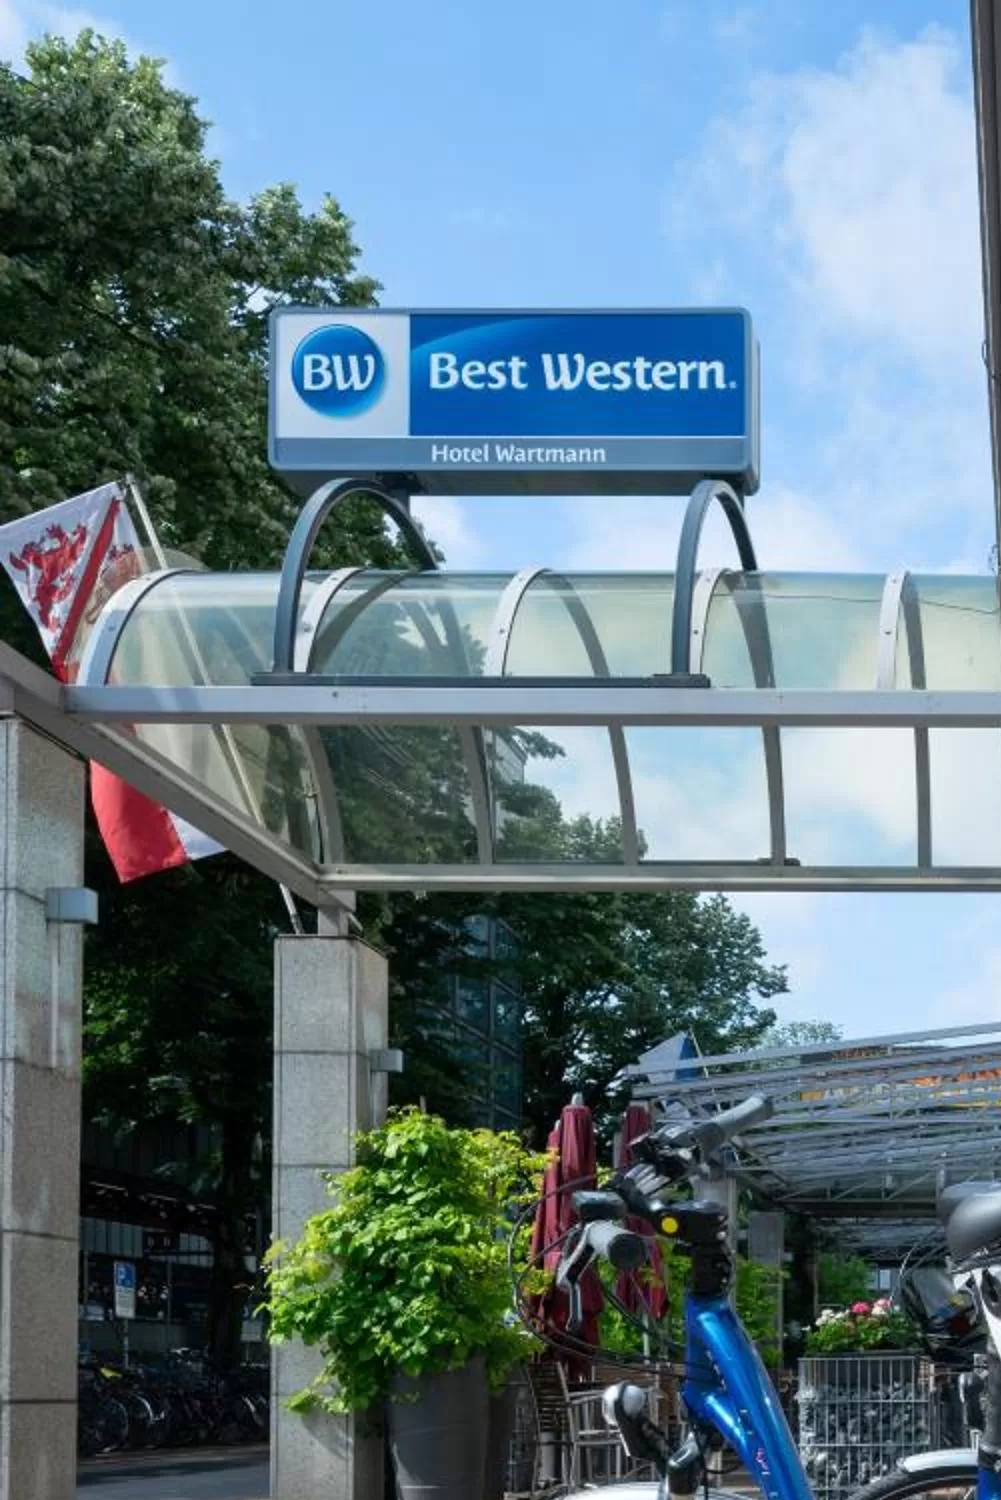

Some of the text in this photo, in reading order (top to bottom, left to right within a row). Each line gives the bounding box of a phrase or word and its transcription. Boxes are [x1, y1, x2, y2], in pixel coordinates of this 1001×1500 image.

[302, 352, 375, 391] BW
[428, 352, 527, 391] Best
[430, 444, 607, 464] Hotel Wartmann
